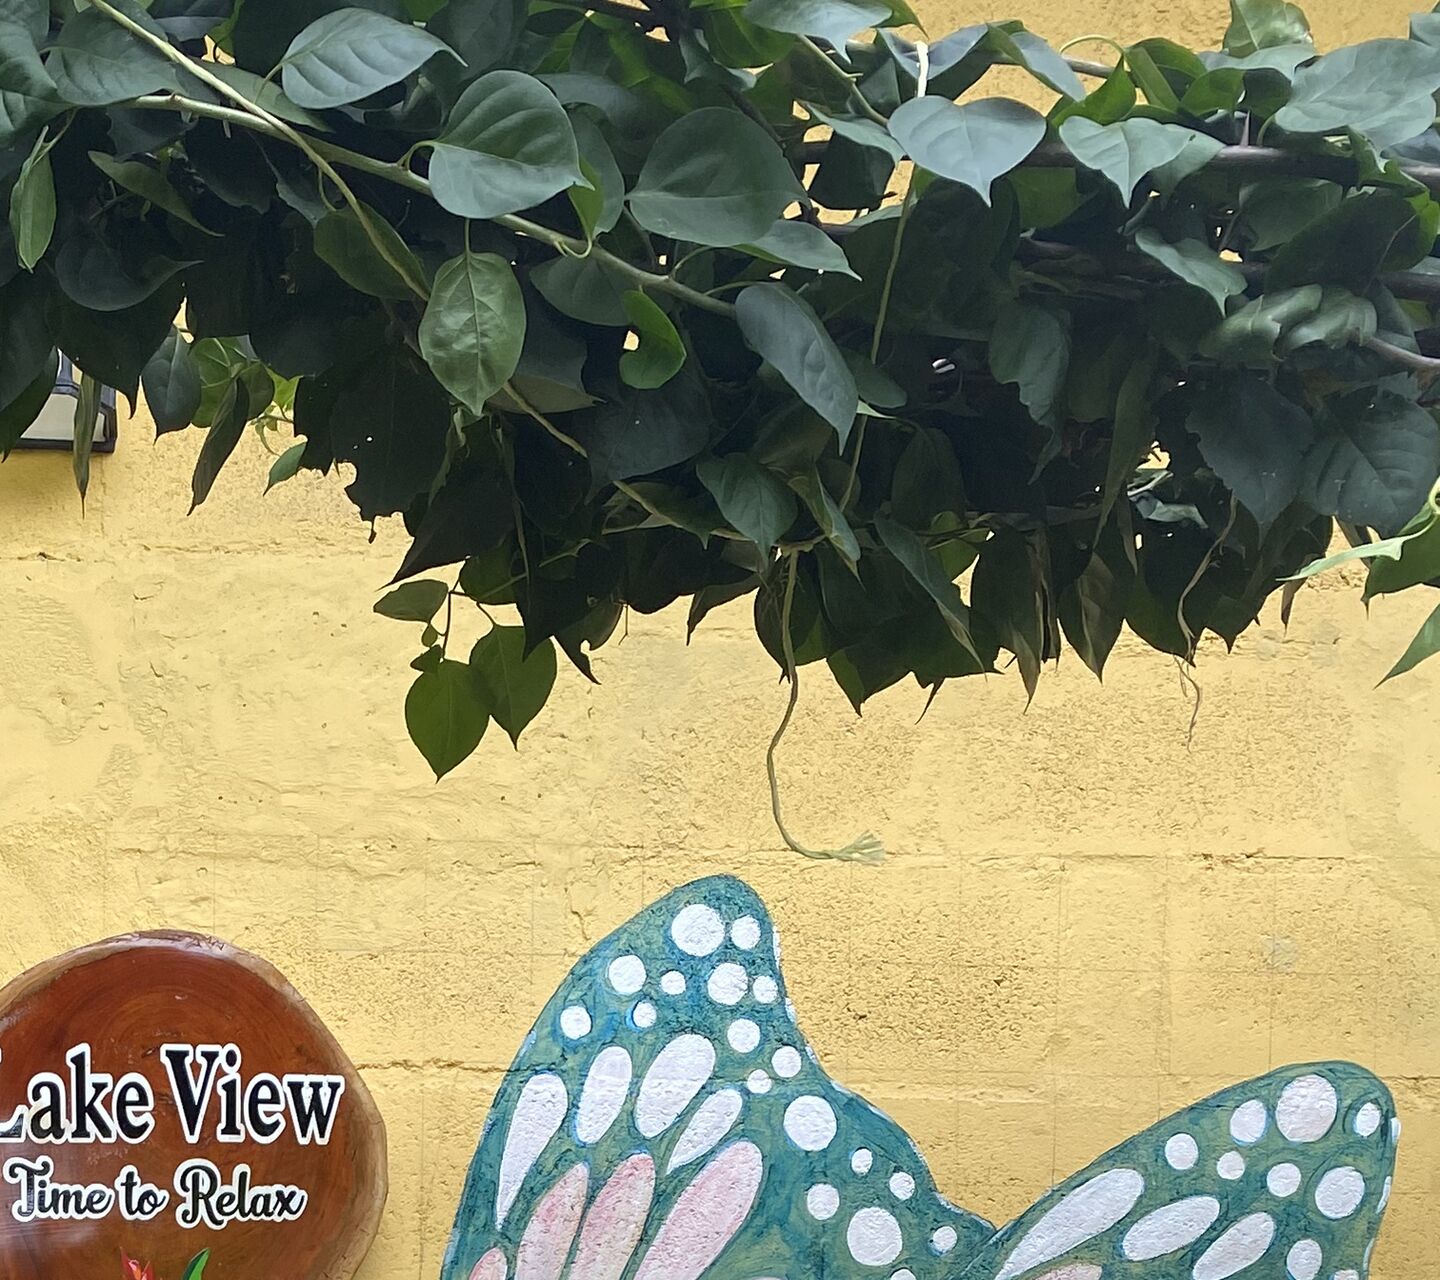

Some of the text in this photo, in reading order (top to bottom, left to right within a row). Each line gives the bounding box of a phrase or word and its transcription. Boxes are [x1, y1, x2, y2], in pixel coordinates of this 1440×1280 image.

[163, 1046, 344, 1143] View
[5, 1157, 307, 1228] Time to Relax
